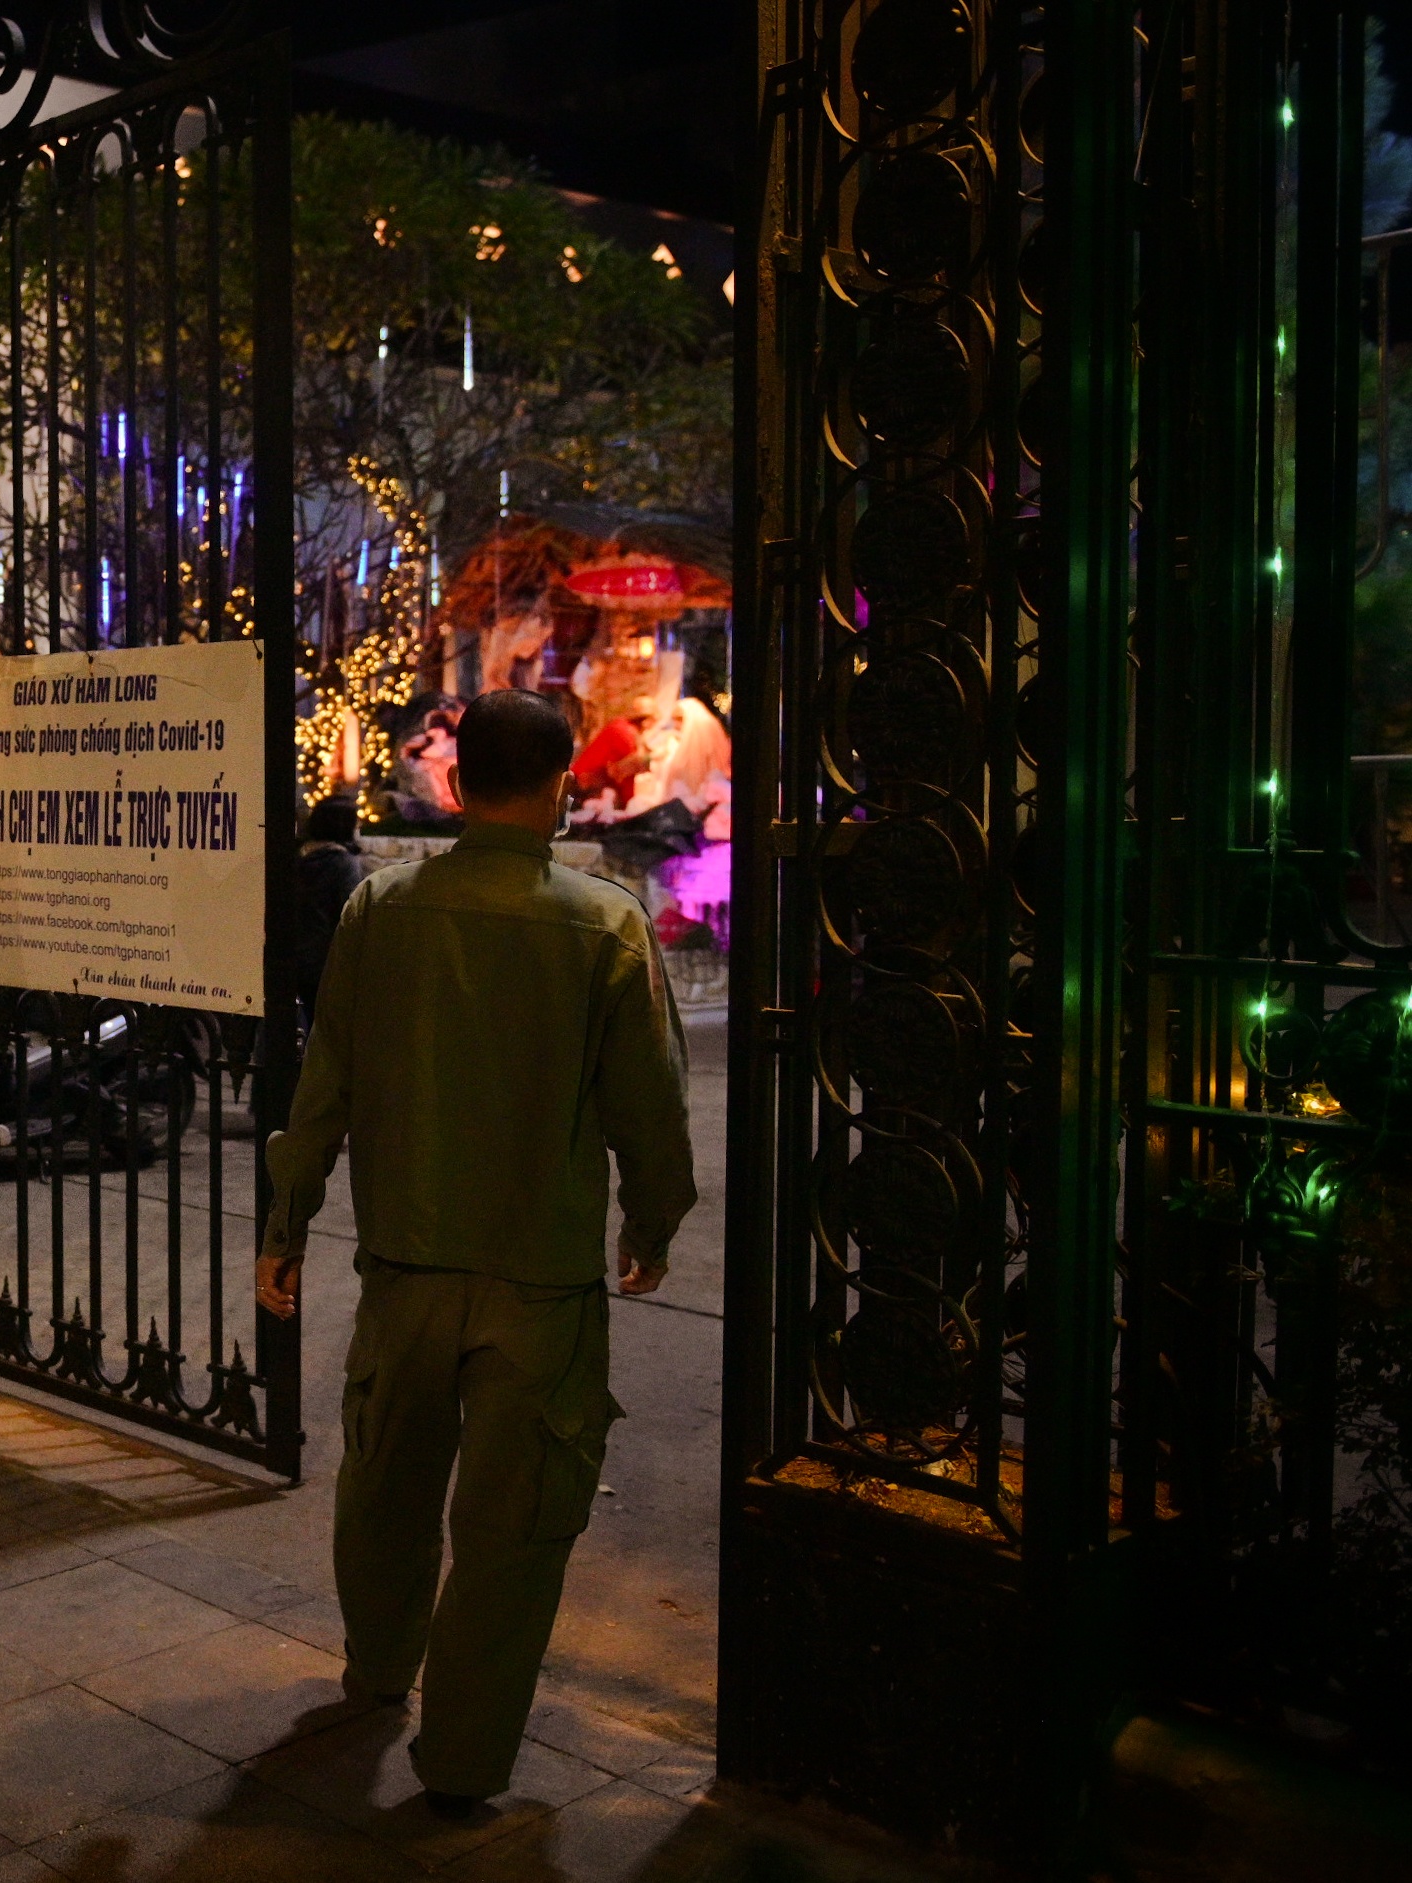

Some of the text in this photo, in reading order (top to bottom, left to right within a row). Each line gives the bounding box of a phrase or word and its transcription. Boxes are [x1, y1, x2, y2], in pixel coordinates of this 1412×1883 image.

[13, 675, 47, 706] GIÁO
[51, 672, 74, 705] XỨ
[114, 674, 158, 702] LONG
[14, 724, 36, 753] sức
[39, 723, 77, 757] phòng
[81, 718, 121, 756] chống
[124, 721, 154, 759] dịch
[158, 719, 225, 752] Covid-19
[9, 789, 32, 856] CHỊ
[38, 790, 60, 844] EM
[64, 790, 99, 847] XEM
[104, 769, 122, 847] LỄ
[128, 785, 171, 862] TRỰC
[176, 772, 237, 851] TUYẾN
[80, 966, 104, 984] Xin
